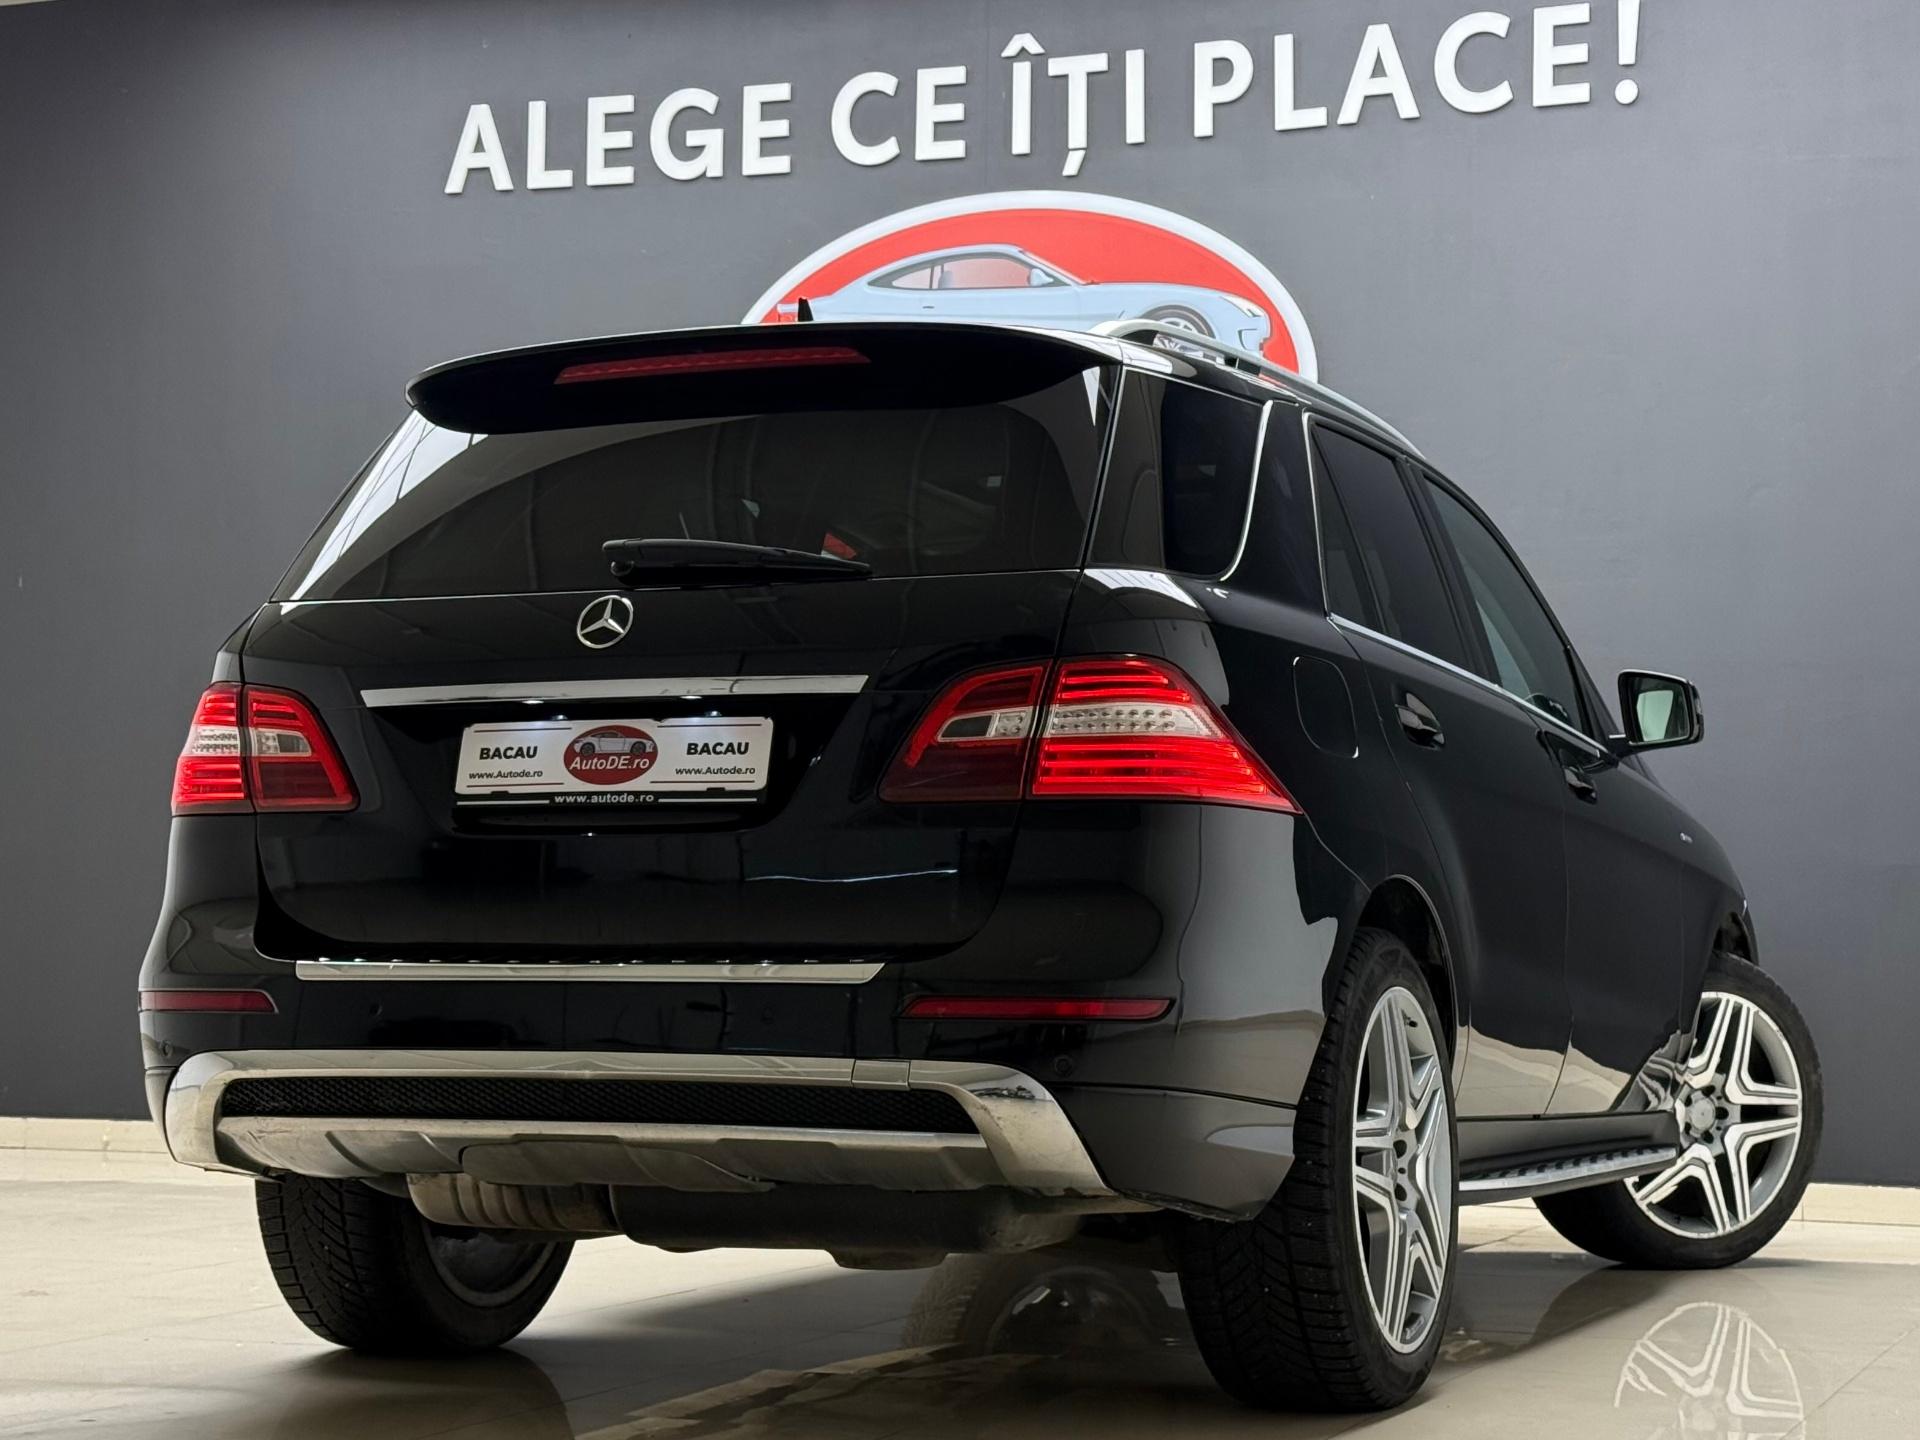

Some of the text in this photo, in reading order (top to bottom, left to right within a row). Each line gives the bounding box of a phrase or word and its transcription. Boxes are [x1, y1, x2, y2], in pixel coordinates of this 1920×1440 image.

[445, 0, 1641, 195] ALEGE CE ÎȚI PLACE!
[479, 746, 538, 760] BACAU
[686, 742, 750, 756] BACAU
[569, 755, 650, 771] AutoDE.ro
[468, 770, 543, 780] www.Autode.ro
[675, 766, 756, 776] www.Autode.ro
[554, 793, 655, 804] www.autode.ro
